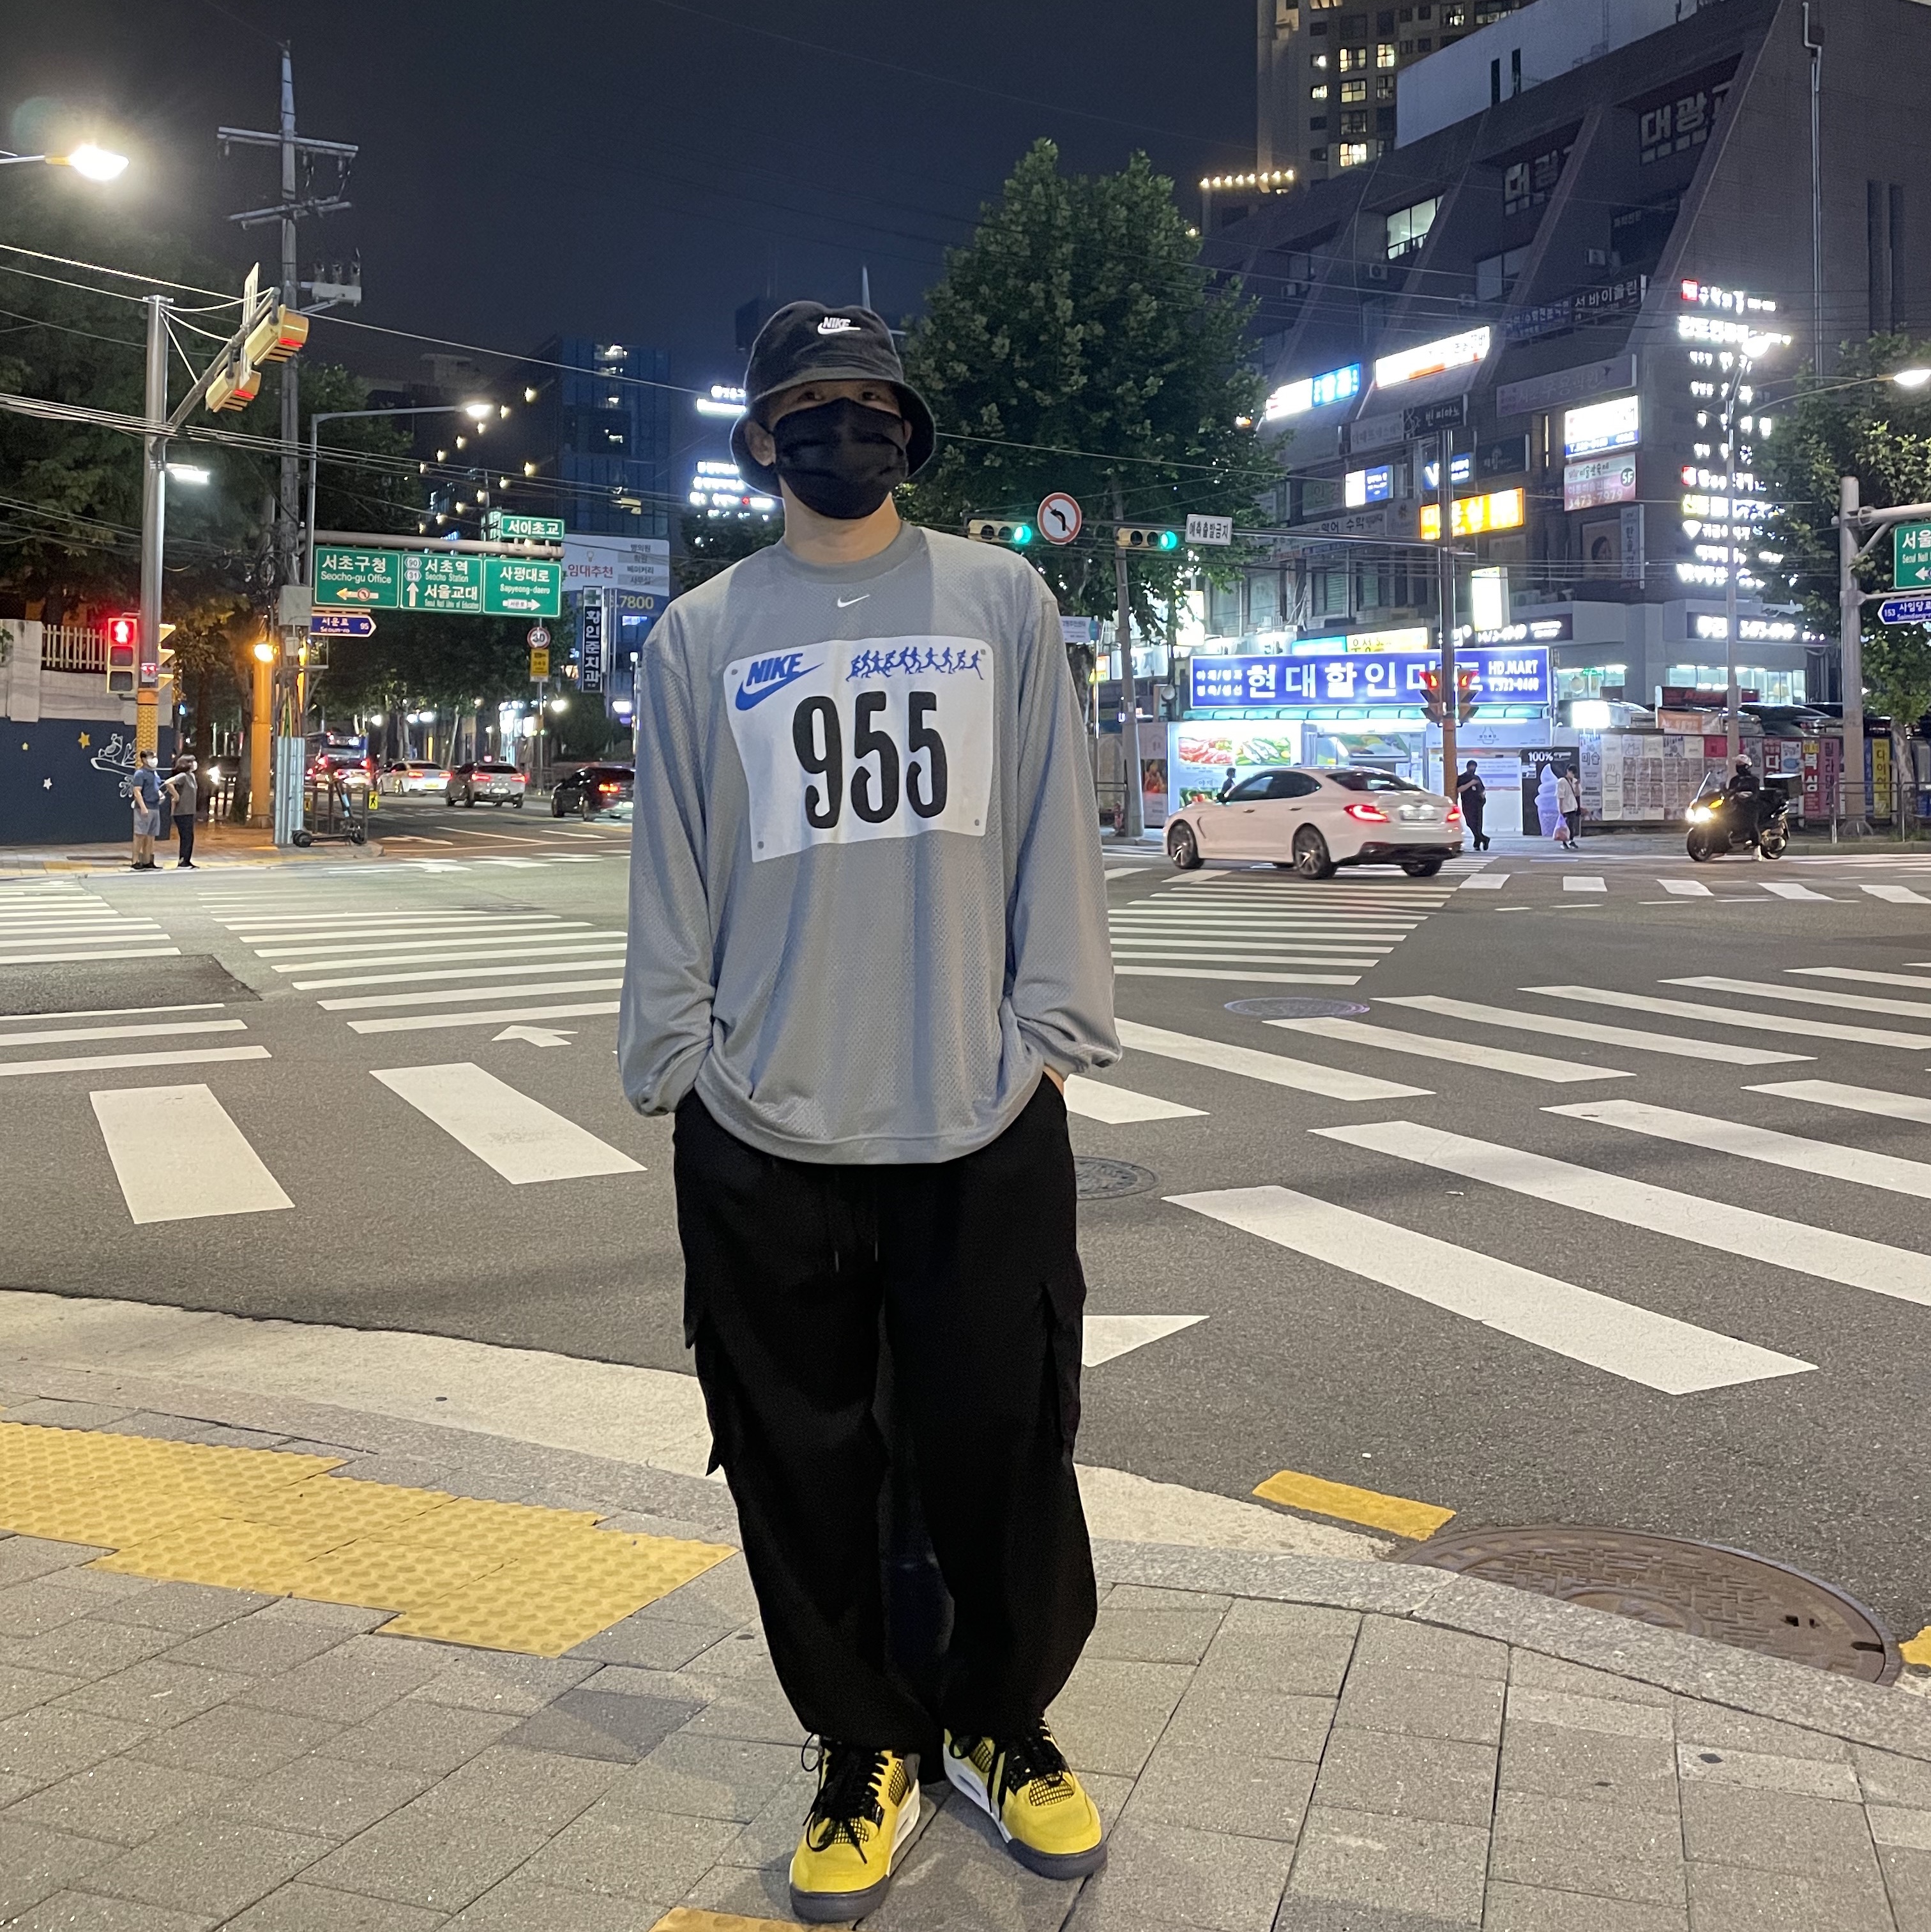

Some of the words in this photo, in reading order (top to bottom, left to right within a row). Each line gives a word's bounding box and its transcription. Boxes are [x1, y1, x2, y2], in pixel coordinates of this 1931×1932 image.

[822, 317, 851, 328] NIKE
[1622, 471, 1633, 484] 5F
[508, 520, 559, 535] 서이초교
[322, 554, 386, 574] 서초구청
[425, 559, 468, 575] 서초역
[626, 566, 654, 574] 베이커리
[321, 571, 366, 584] Seocho-gu
[368, 573, 391, 584] Office
[448, 573, 469, 582] Station
[500, 567, 550, 582] 사평대로
[568, 565, 613, 579] 임대추천
[424, 584, 478, 600] 서울교대
[500, 584, 550, 595] Sapyeong-daero
[1884, 609, 1896, 617] 153
[532, 632, 545, 642] 30
[746, 653, 803, 687] NIKE
[792, 690, 948, 829] 955
[1528, 751, 1553, 762] 100%
